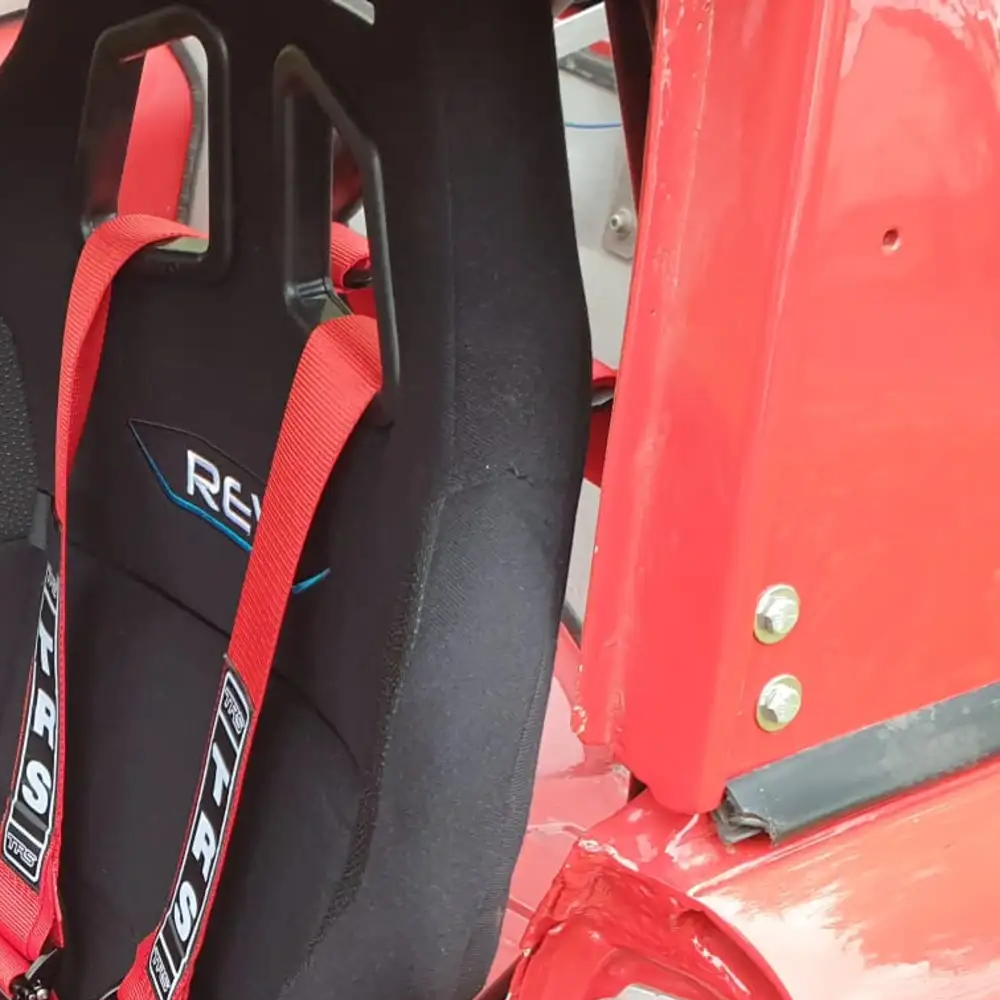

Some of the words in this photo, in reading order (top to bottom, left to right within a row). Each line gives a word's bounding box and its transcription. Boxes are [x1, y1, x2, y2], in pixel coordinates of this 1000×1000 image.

[21, 620, 57, 815] TRS
[6, 832, 38, 868] TRS
[174, 742, 230, 942] TRS
